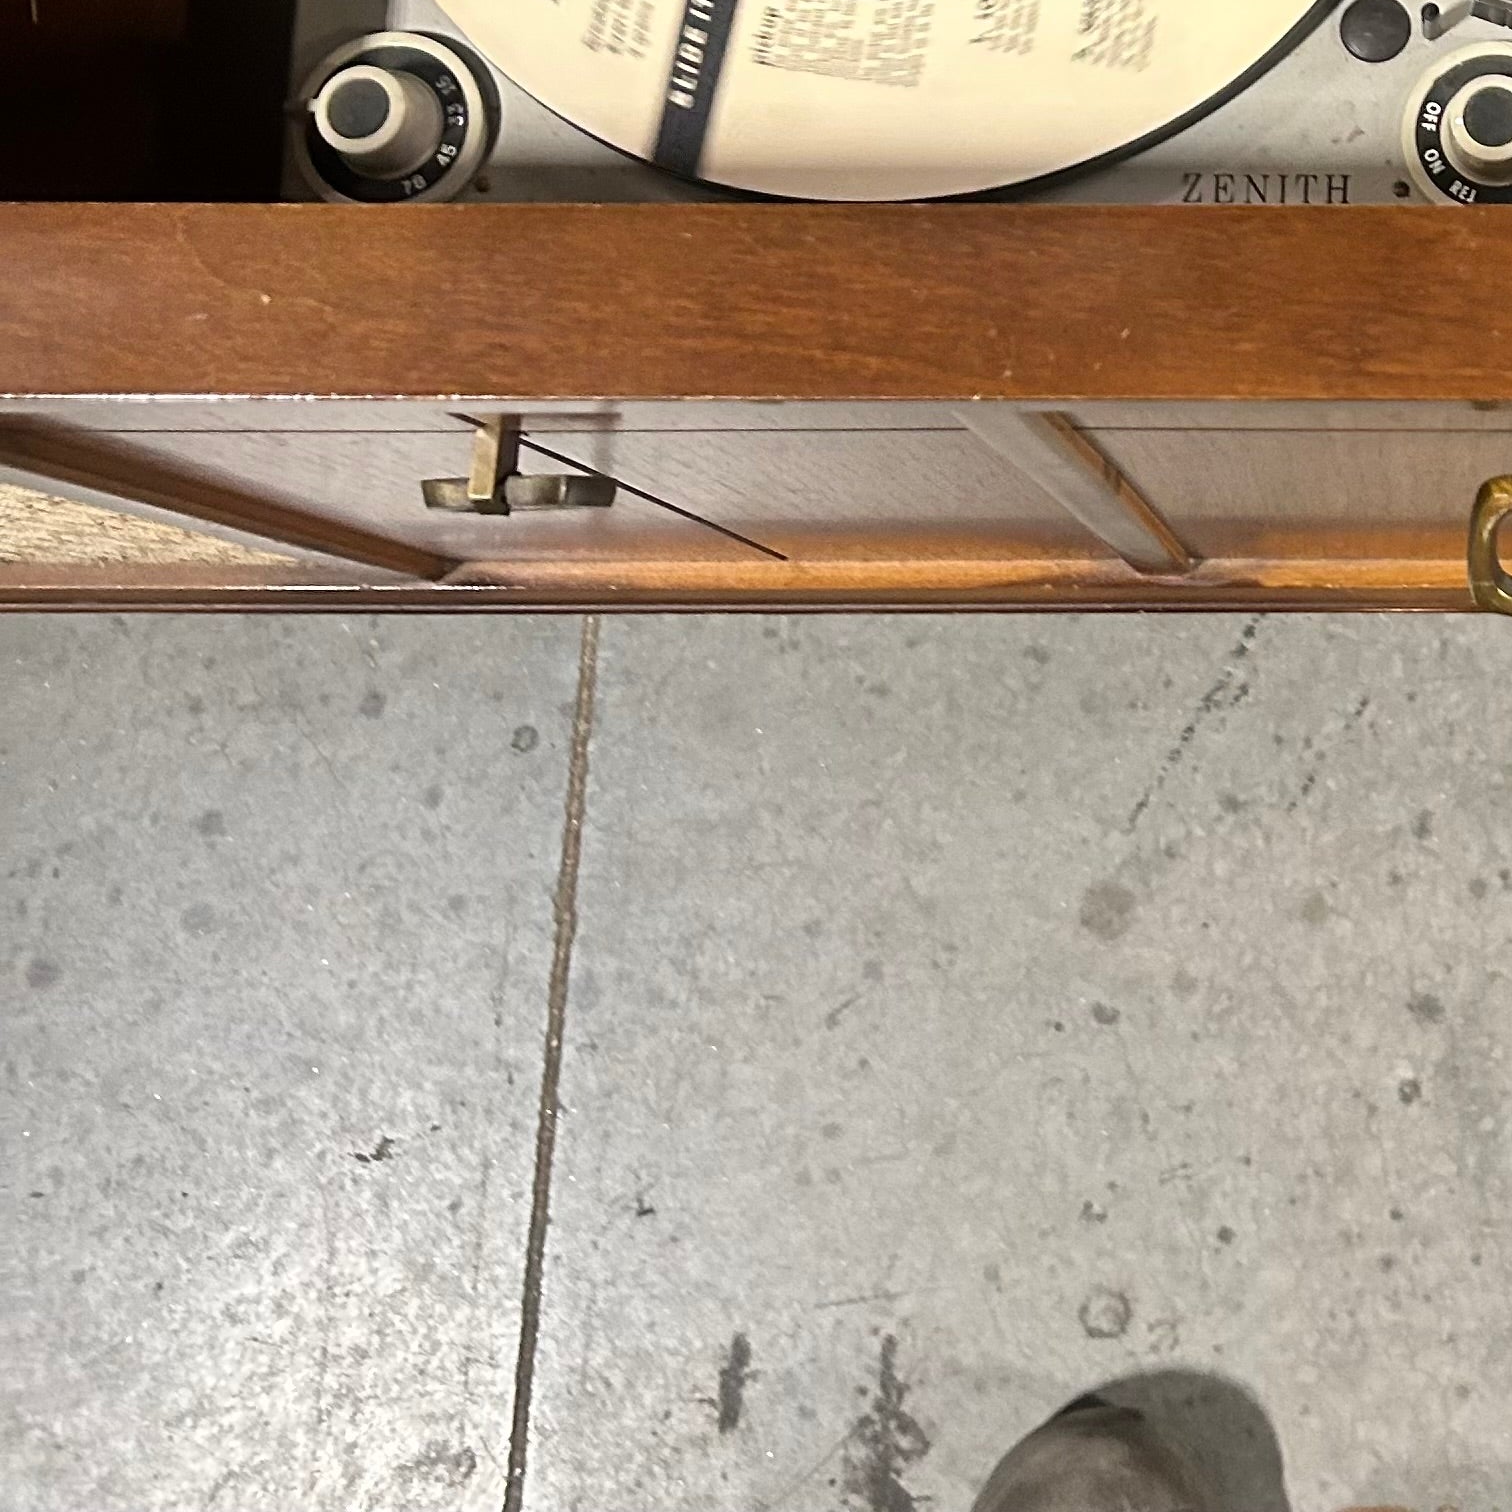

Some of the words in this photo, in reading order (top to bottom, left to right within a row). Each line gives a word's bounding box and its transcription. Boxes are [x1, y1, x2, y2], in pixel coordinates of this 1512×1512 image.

[1420, 101, 1442, 133] OFF
[1424, 148, 1447, 175] ON
[1182, 172, 1352, 205] ZENITH
[1448, 179, 1478, 203] REJ
